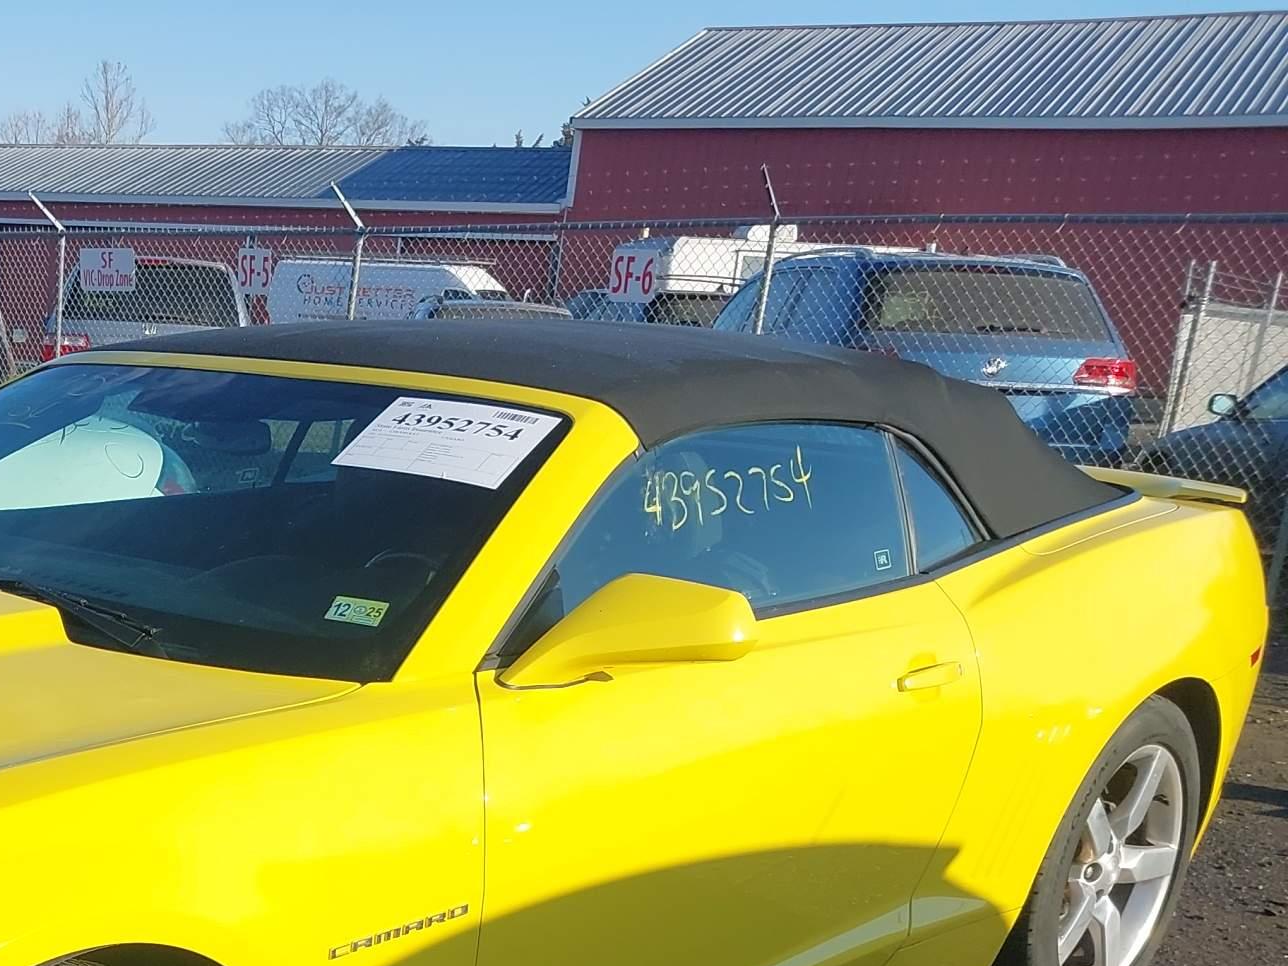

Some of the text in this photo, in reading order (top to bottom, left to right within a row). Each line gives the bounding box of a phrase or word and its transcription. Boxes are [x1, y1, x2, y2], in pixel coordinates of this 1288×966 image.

[101, 252, 114, 269] SF
[240, 255, 269, 288] SF-5
[611, 256, 654, 295] SF-6
[303, 296, 414, 311] HOME ERVICES
[356, 287, 416, 299] ETTER
[391, 411, 524, 441] 43952754
[644, 444, 812, 532] 43952754
[333, 602, 384, 619] 12 25
[327, 903, 469, 961] CAMARO
